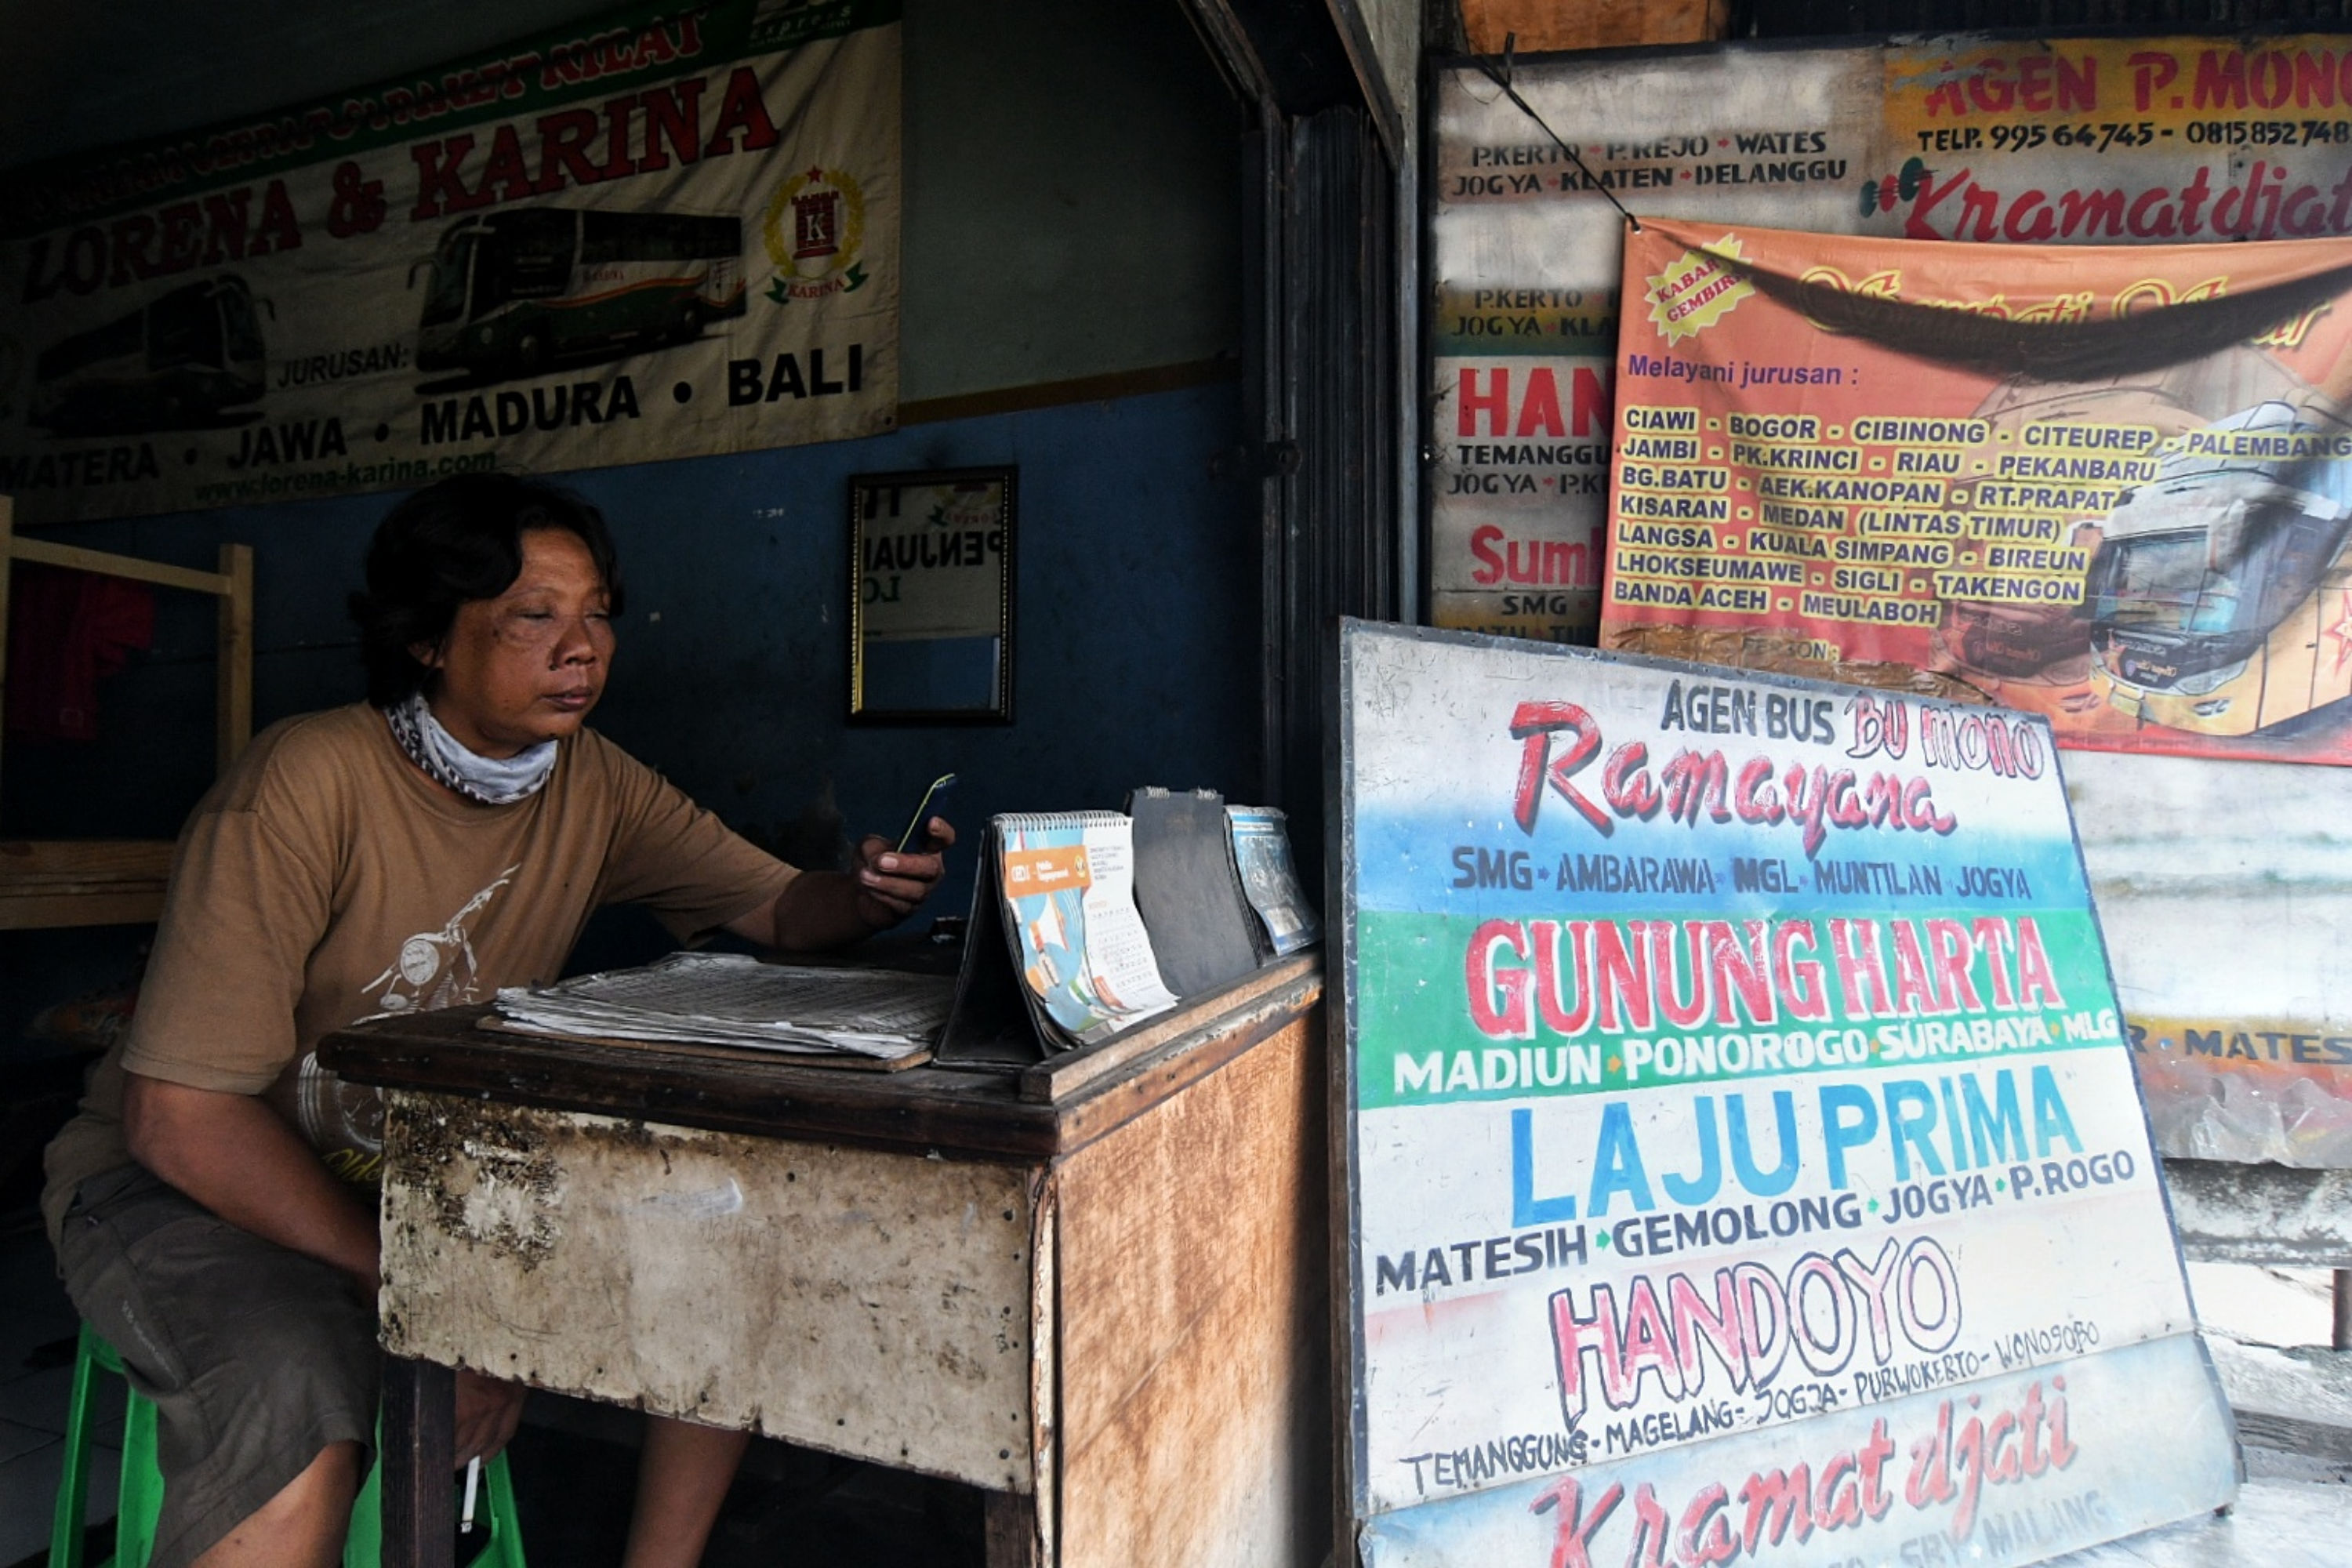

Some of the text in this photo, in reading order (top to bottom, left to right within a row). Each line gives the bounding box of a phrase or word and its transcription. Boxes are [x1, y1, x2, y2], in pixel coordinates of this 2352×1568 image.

[1924, 49, 2352, 117] AGEN P.MON
[1472, 131, 1828, 167] P.KERTO P.REJO WATES
[1918, 129, 1983, 153] TELP.
[21, 180, 303, 304] LORENA
[412, 66, 780, 221] KARINA
[1452, 159, 1847, 197] JOGYA KLATEN DELANGGU
[804, 212, 826, 242] K
[787, 276, 845, 299] KARINA
[1475, 288, 1583, 310] P.KERTO
[1656, 258, 1722, 304] KABAR
[1452, 316, 1542, 336] JOGYA
[277, 343, 410, 388] JURUSAN:
[1628, 354, 1842, 389] Melayani jurusan
[227, 417, 347, 470] JAWA
[420, 376, 641, 445] MADURA
[728, 343, 862, 406] BALI
[1457, 368, 1614, 437] HAN
[1457, 445, 1610, 465] TEMANGGU
[1625, 408, 2352, 456] CIAWI BOGOR CIBINONG CITEUREP PALEMBANG
[193, 452, 497, 503] www.lorena-karina.com
[1623, 438, 2157, 482] JAMBI PK.KRINCI RIAU PEKANBARU
[1447, 474, 1537, 495] JOGYA
[1622, 466, 1727, 491] BG.BATU
[1759, 477, 1941, 504] AEK.KANOPAN
[1621, 495, 2061, 543] KISARAN MEDAN (LINTAS TIMUR)
[1617, 524, 2086, 572] LANGSA KUALA SIMPANG BIREUN
[1616, 552, 2081, 601] LHOKSEUMAWE SIGLI TAKENGON
[1502, 595, 1566, 615] SMG
[1613, 583, 1692, 607] BANDA
[1700, 588, 1768, 611] ACEH
[1802, 594, 1938, 624] MEULABOH
[1660, 679, 1757, 735] AGEN
[1766, 692, 1835, 745] BUS
[1509, 699, 1958, 861] Ramayana
[1452, 846, 2033, 901] SMG AMBARAWA MGL MUNTILAN JOGYA
[1465, 915, 2068, 1040] GUNUNG HARTA
[1394, 1043, 1602, 1094] MADIUN
[1623, 1029, 1870, 1082] PONOROGO
[1876, 1015, 2053, 1061] SURABAYA
[2060, 1008, 2118, 1044] MLG
[1512, 1065, 2085, 1229] LAJU PRIMA
[1376, 1149, 2135, 1297] MATESIH GEMOLONG JOGYA P.ROGO
[1548, 1235, 1962, 1432] HANDOYO
[1399, 1428, 1588, 1495] TEMANGGUNG
[1606, 1399, 1735, 1454] MAGELANG
[1854, 1350, 1980, 1405] PURWOKERTO
